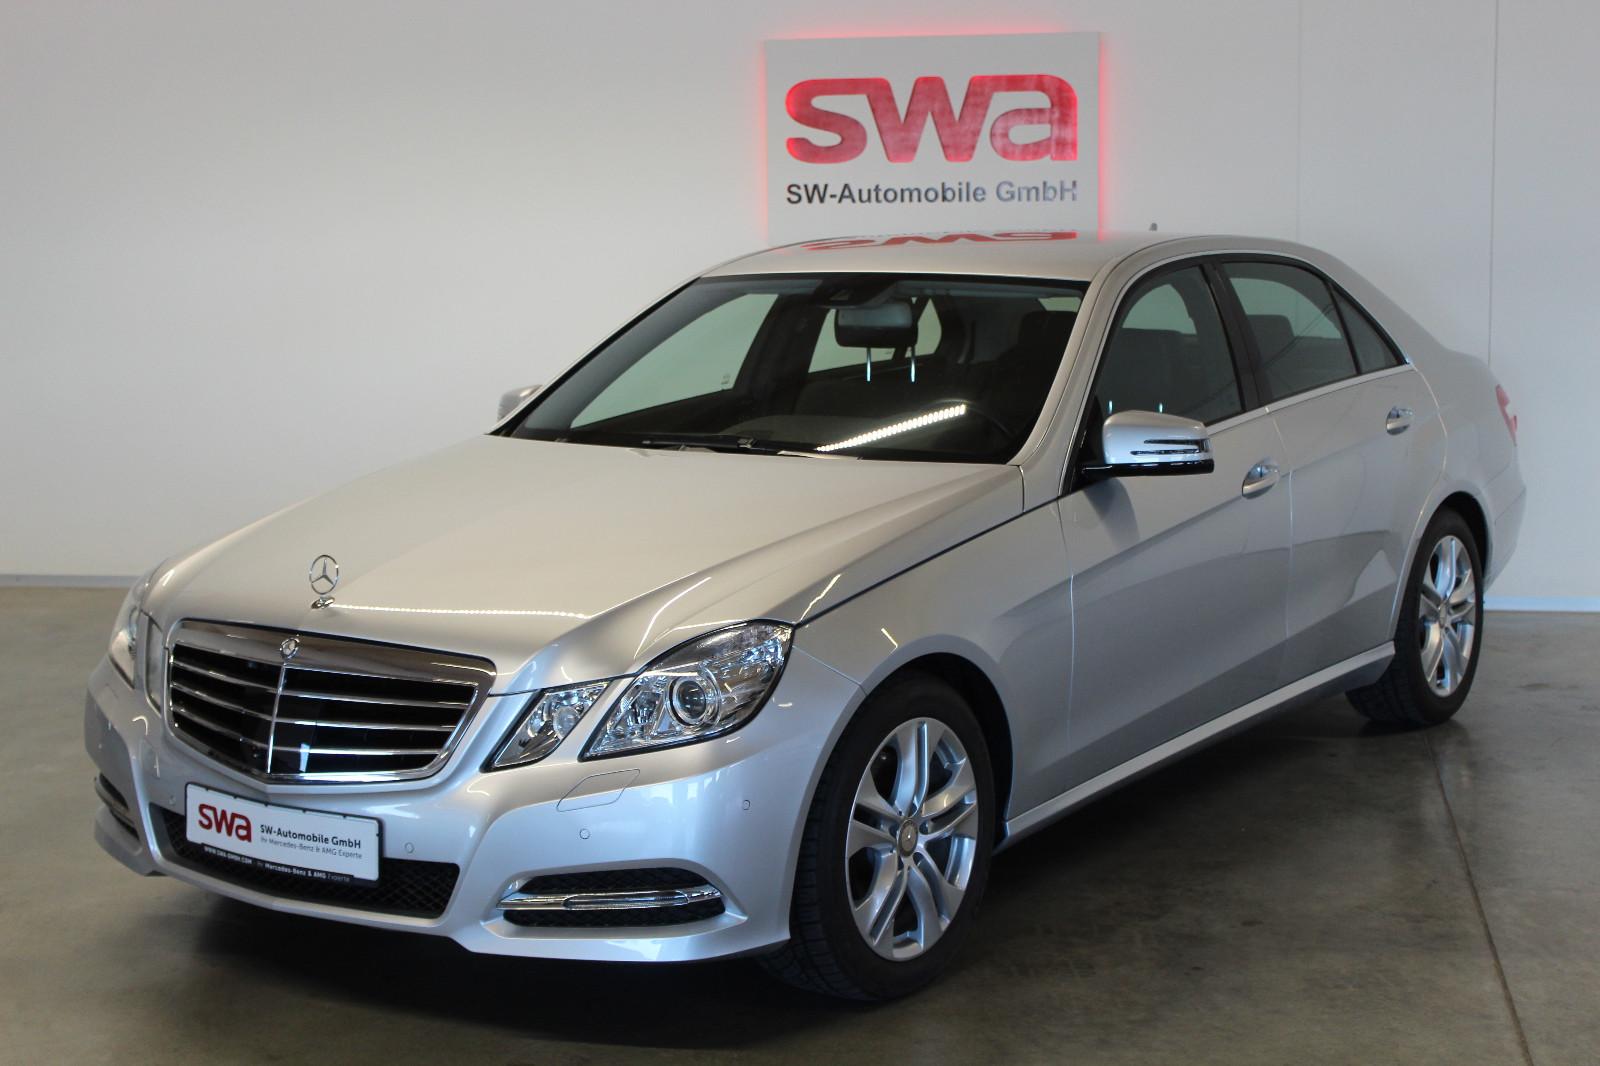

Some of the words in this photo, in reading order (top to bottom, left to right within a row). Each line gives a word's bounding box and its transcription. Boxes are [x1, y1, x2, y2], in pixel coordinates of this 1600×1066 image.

[786, 182, 986, 204] SW-Automobile
[995, 180, 1078, 202] GmbH
[260, 824, 329, 845] SW-Automobile
[331, 836, 361, 849] GmbH
[268, 838, 314, 853] Mercedes-Benz
[321, 847, 337, 856] AMG
